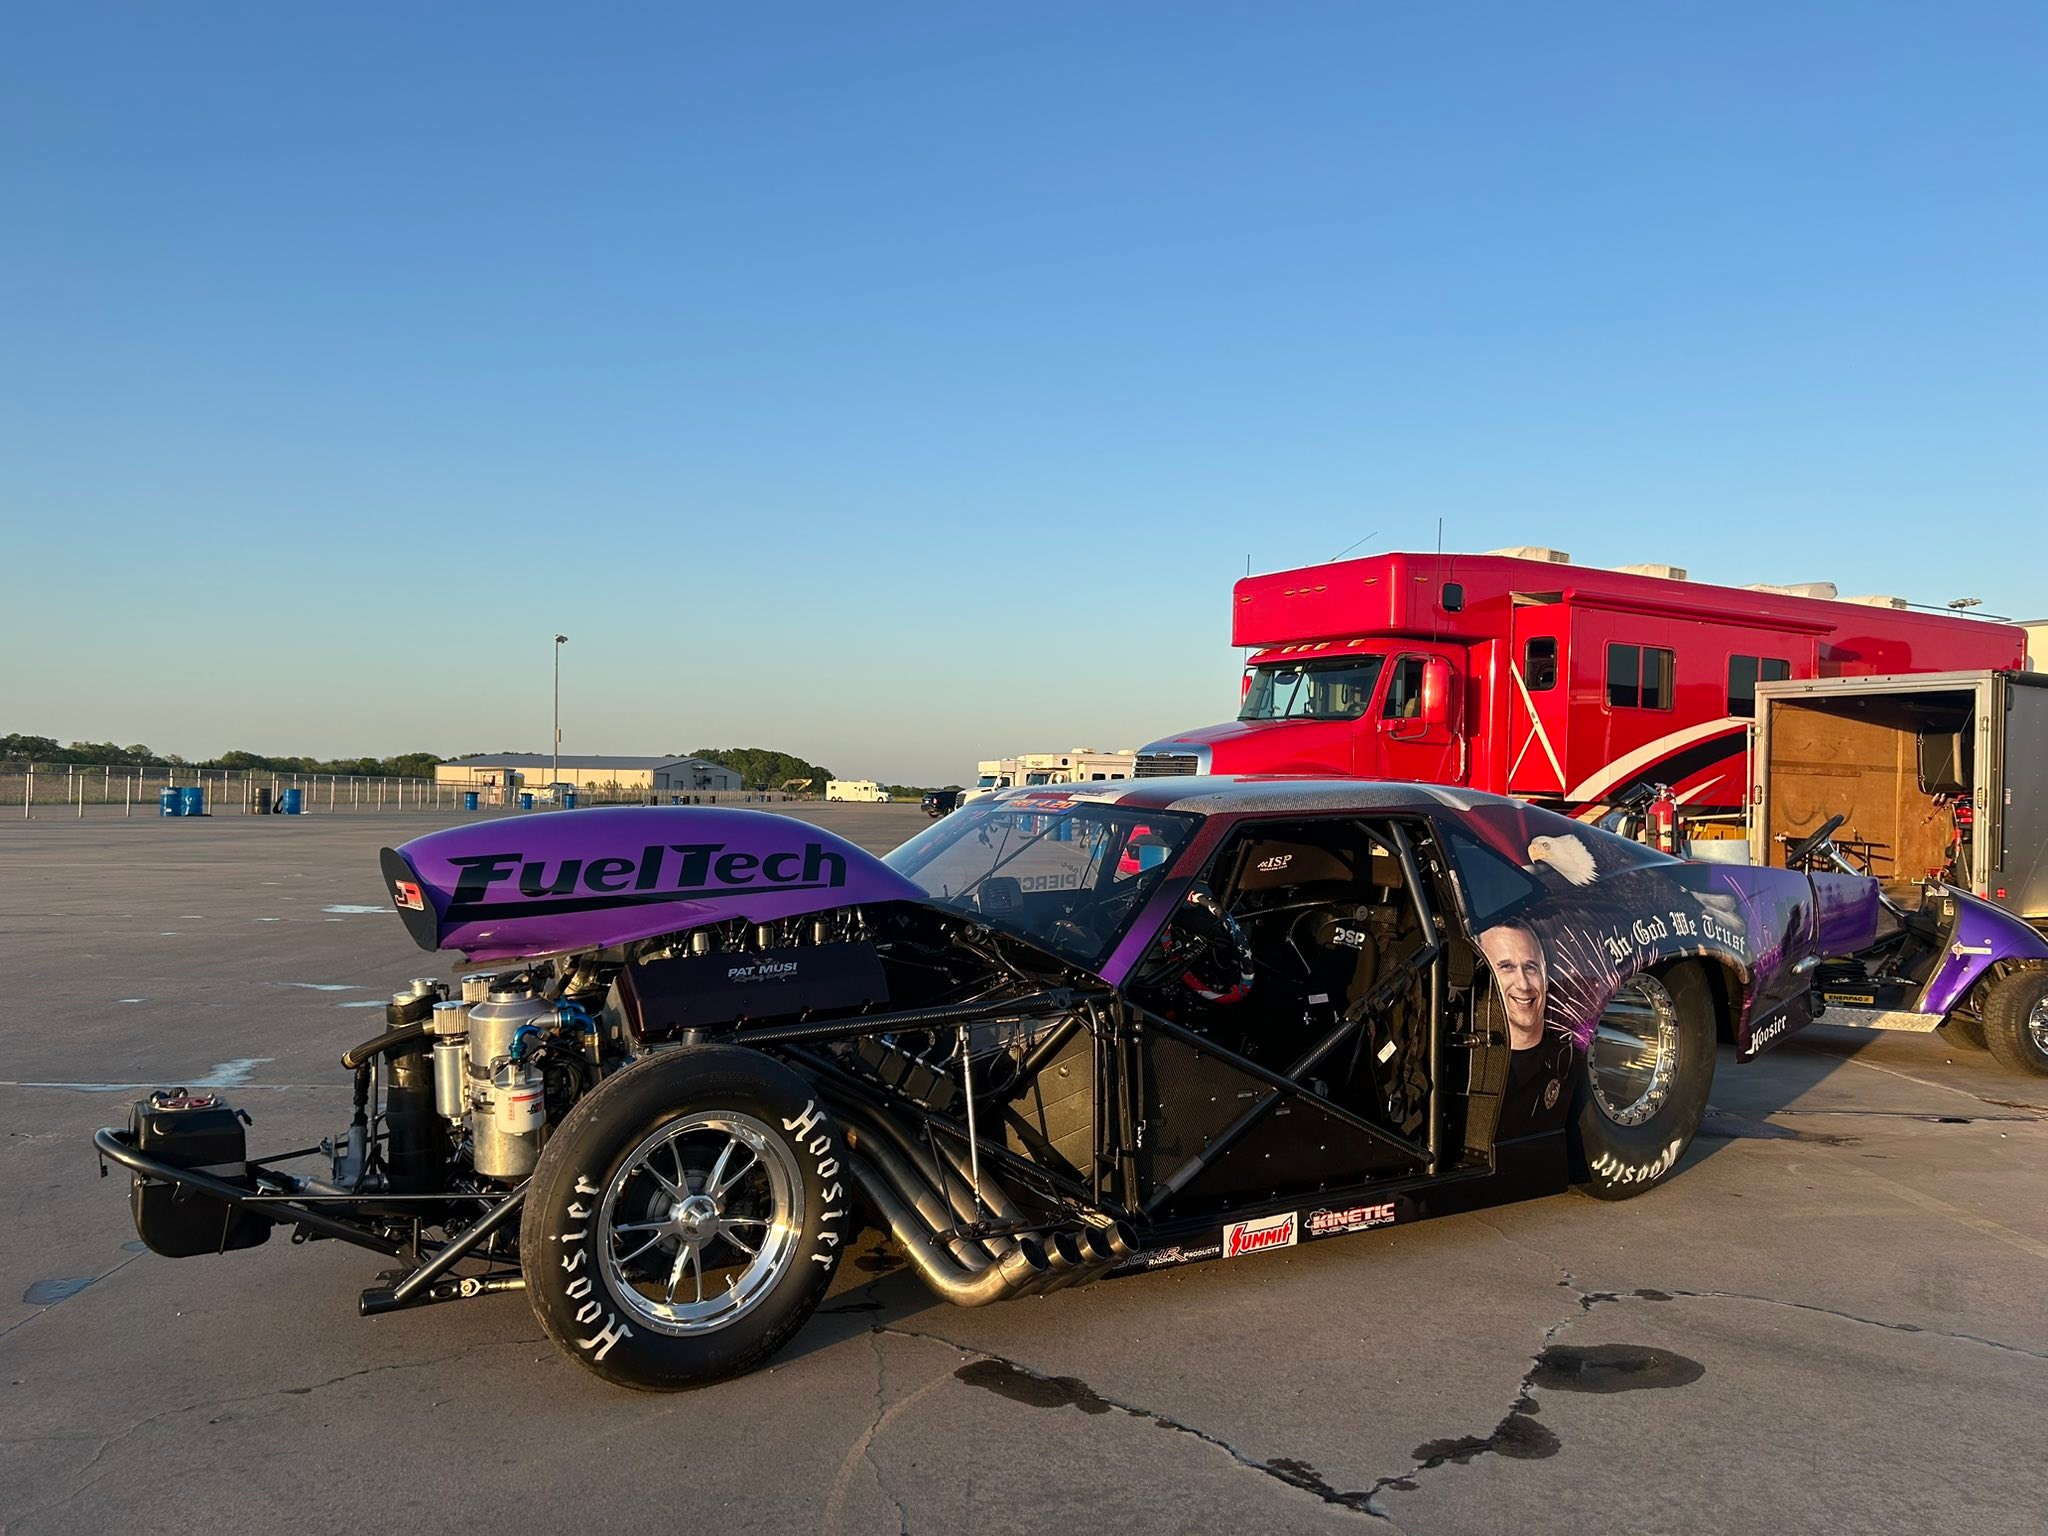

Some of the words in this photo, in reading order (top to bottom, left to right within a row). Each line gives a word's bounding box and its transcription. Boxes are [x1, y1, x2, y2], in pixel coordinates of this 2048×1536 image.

[446, 843, 847, 903] FuelTech
[1267, 854, 1293, 868] ISP
[1604, 936, 1633, 966] In
[1633, 915, 1669, 946] God
[1669, 911, 1698, 937] We
[1701, 914, 1746, 955] Trust
[728, 966, 756, 977] PAT
[759, 962, 798, 974] MUSI
[1828, 994, 1863, 1003] ENERPAC
[1744, 1015, 1787, 1054] Hoosier
[1591, 1137, 1682, 1188] Hoosier
[782, 1099, 848, 1271] Hoosier
[1311, 1202, 1395, 1230] KINETIC
[549, 1172, 634, 1361] Hoosier
[1183, 1246, 1220, 1259] PRODUCTS
